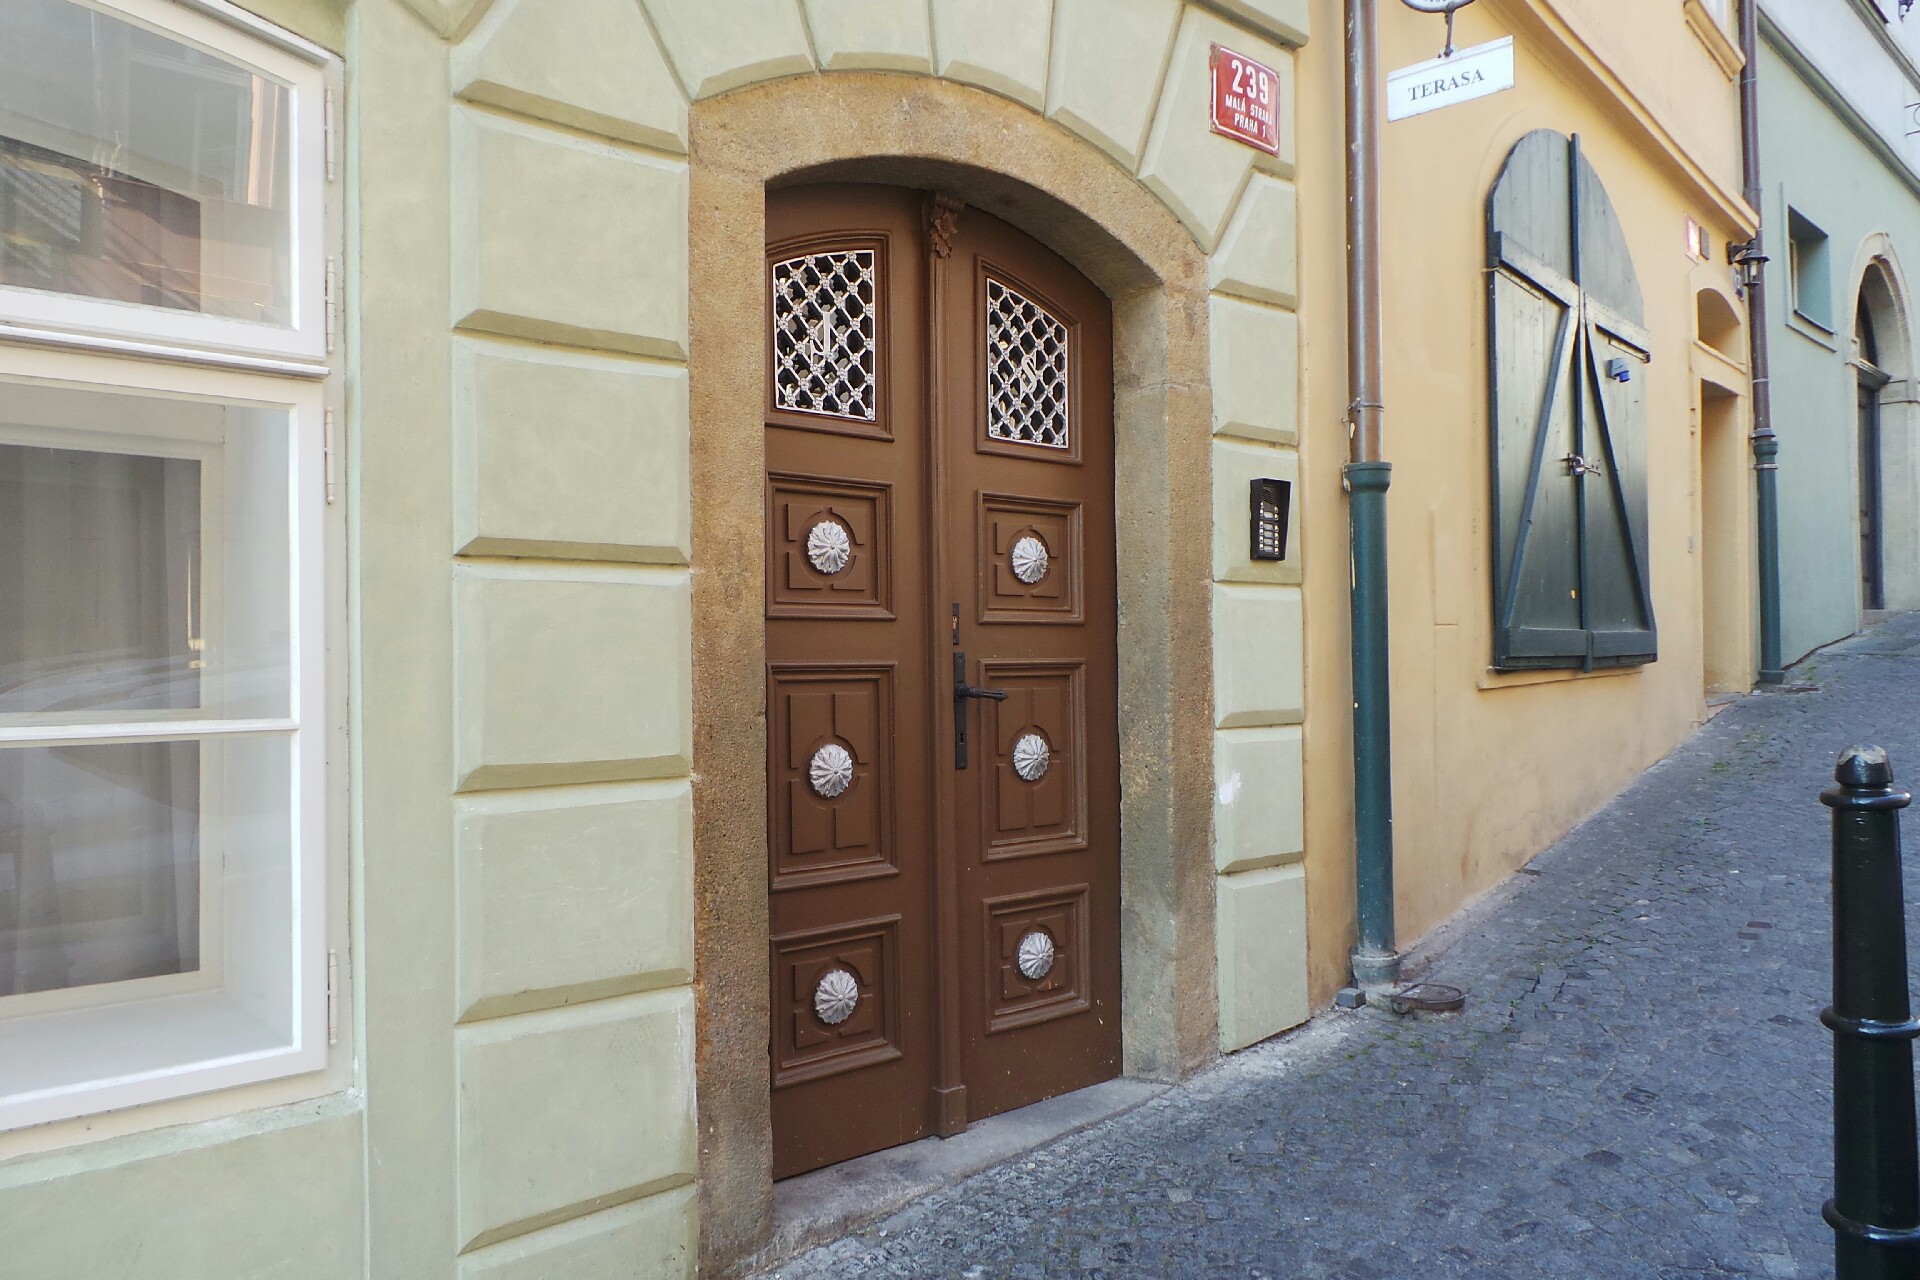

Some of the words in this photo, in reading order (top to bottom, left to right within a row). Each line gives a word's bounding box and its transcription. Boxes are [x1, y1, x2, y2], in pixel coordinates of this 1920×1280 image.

[1231, 59, 1269, 105] 239
[1408, 69, 1485, 101] TERASA
[1225, 94, 1246, 112] MALÁ
[1250, 104, 1273, 125] STRANA
[1234, 114, 1258, 134] PRAHA
[1262, 126, 1266, 138] 1
